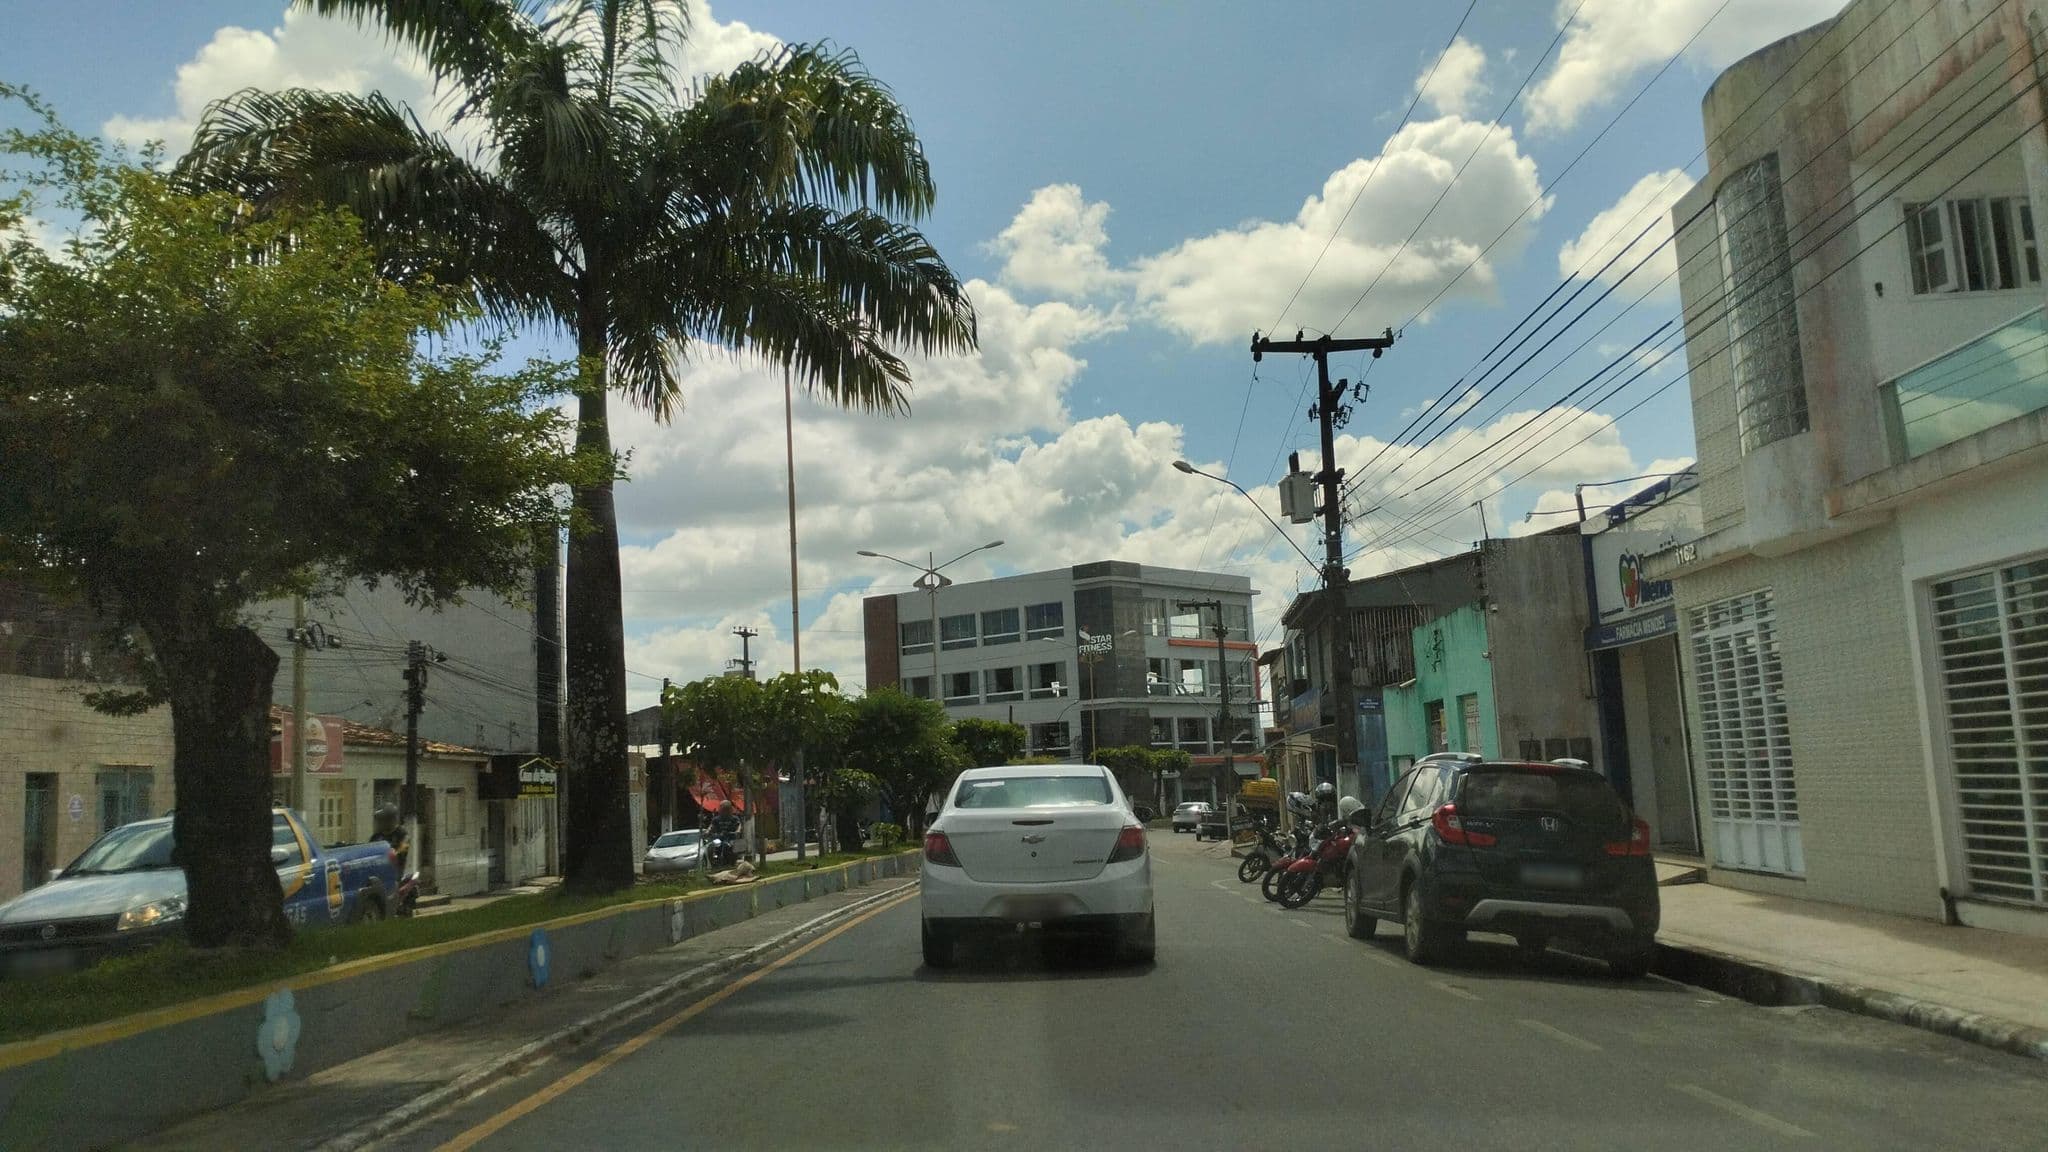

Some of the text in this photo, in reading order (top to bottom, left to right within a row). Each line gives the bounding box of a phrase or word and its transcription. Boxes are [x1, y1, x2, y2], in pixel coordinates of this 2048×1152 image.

[1675, 544, 1697, 566] 1162
[1643, 614, 1666, 633] MENDES
[1090, 634, 1112, 644] STAR
[1079, 643, 1113, 653] FITNESS
